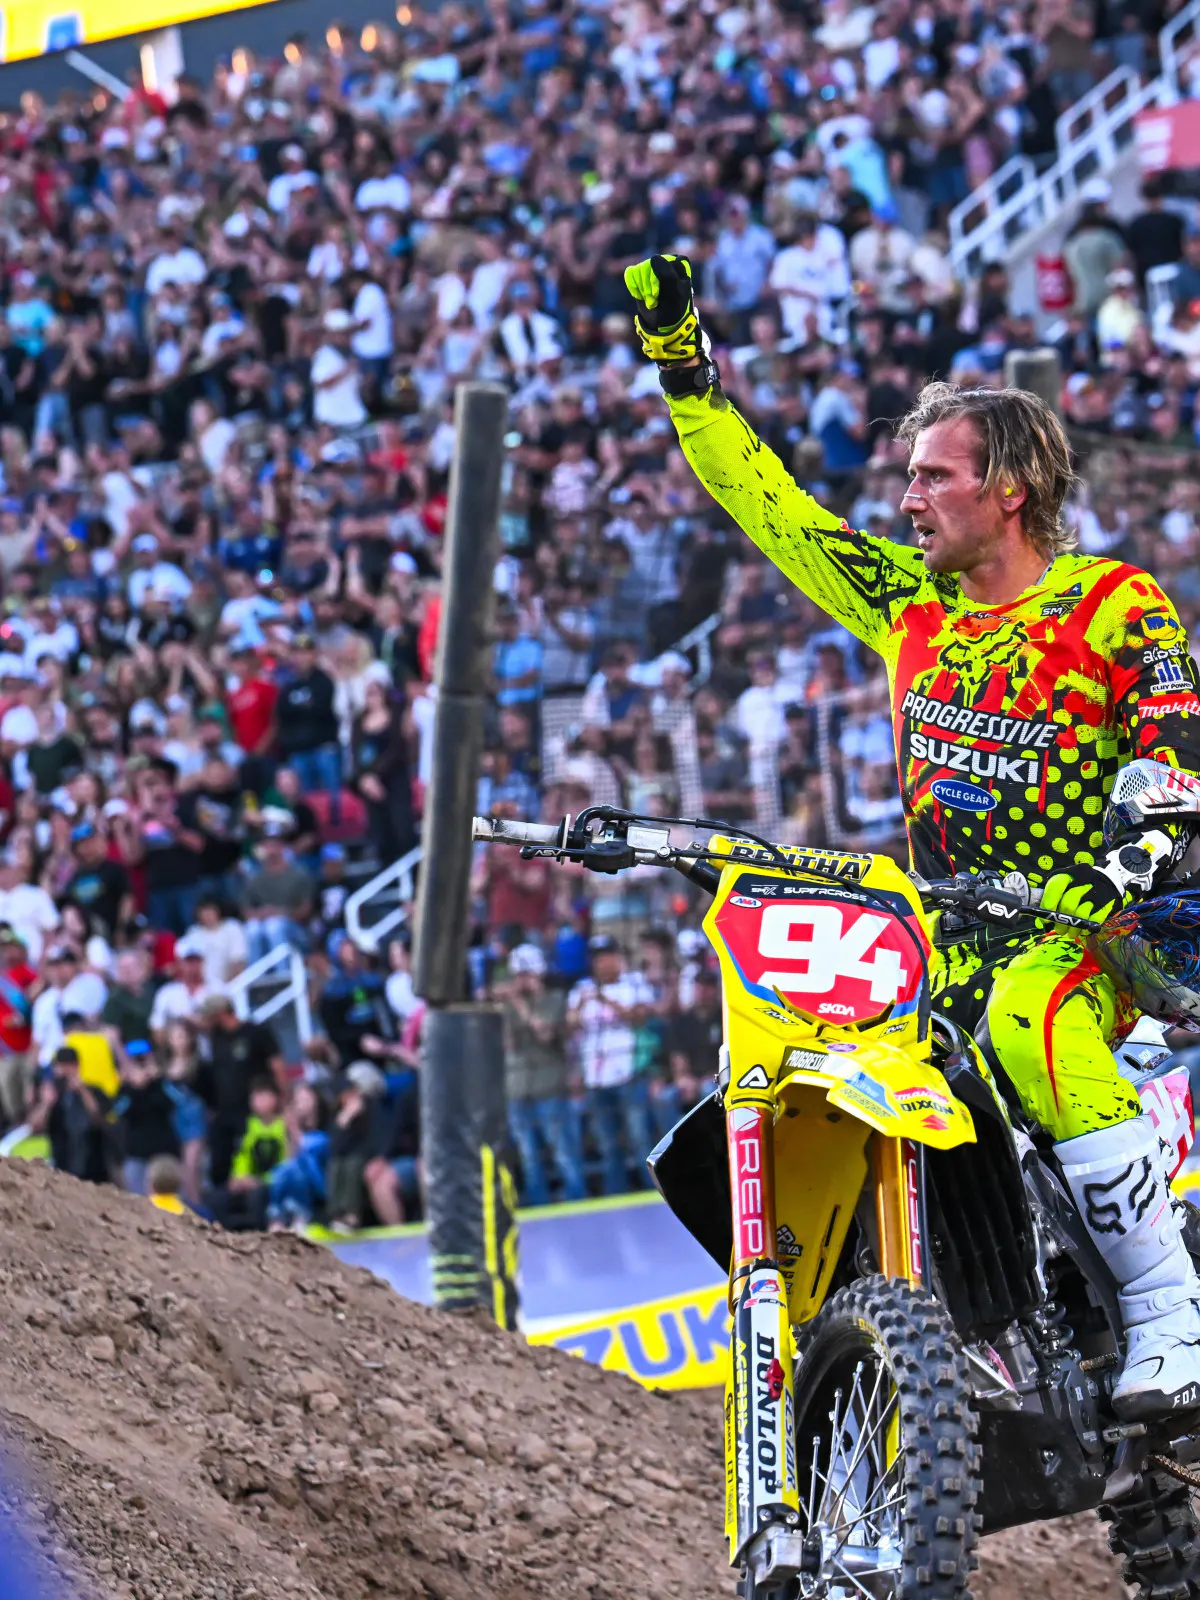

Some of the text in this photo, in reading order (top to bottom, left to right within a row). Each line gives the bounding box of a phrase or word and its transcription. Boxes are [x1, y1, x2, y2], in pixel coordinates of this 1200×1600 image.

[901, 692, 1058, 748] PROGRESSIVE
[910, 733, 1039, 784] SUZUKI
[934, 785, 989, 805] CYCLE GEAR
[783, 886, 868, 902] SUPERCROSS
[977, 900, 1018, 919] ASV
[1047, 912, 1081, 926] ASV
[757, 904, 908, 1004] 94
[817, 1003, 855, 1017] SKDA
[900, 1100, 954, 1115] DIXXON
[739, 1138, 763, 1253] REP
[736, 1337, 748, 1434] ACERBIS
[1172, 1385, 1196, 1408] FOX
[757, 1331, 777, 1495] DUNLOP
